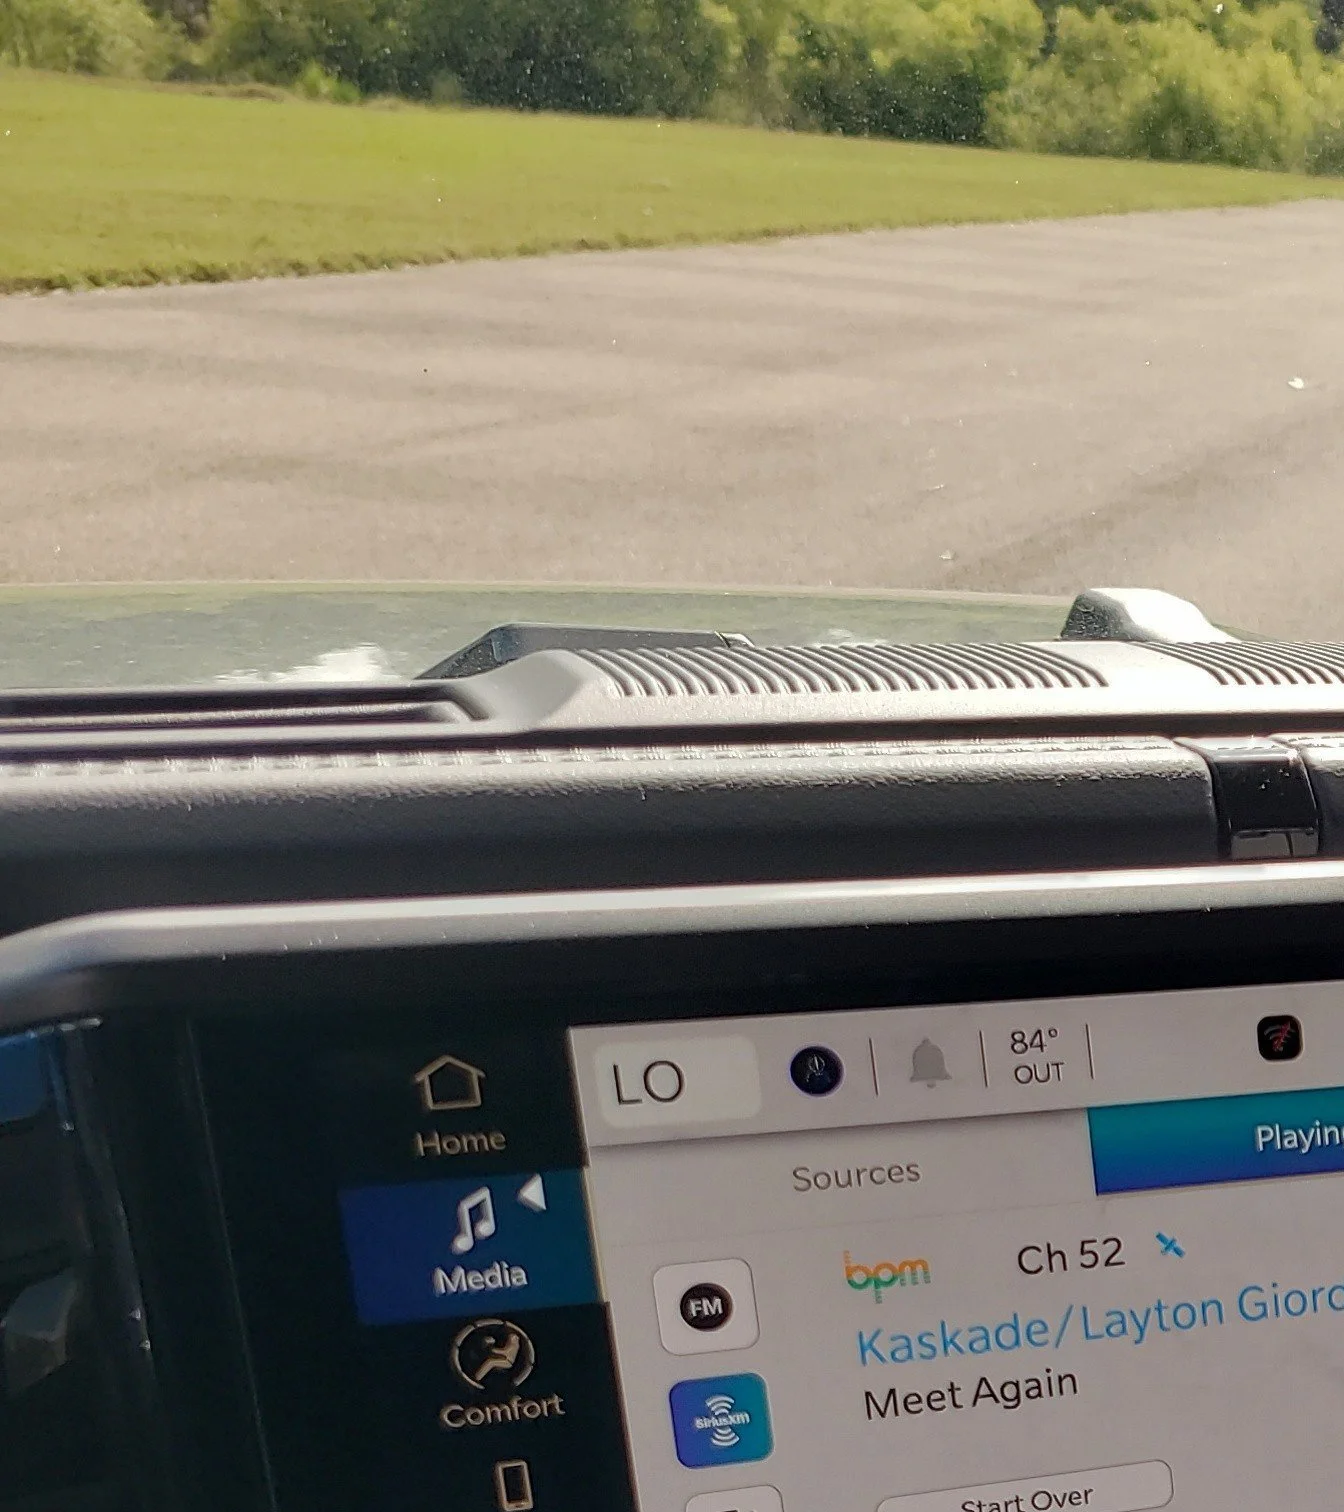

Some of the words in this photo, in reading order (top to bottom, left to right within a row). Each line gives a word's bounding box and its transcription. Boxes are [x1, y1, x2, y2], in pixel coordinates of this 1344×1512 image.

[613, 1059, 685, 1105] LO
[1014, 1061, 1066, 1086] OUT
[416, 1129, 506, 1158] Home
[792, 1158, 921, 1193] Sources
[1016, 1241, 1068, 1277] Ch
[1079, 1237, 1126, 1270] 52
[434, 1262, 528, 1295] Media
[843, 1250, 931, 1304] bpm
[689, 1296, 724, 1317] FM
[857, 1296, 1225, 1367] Kaskade/Layton
[440, 1392, 566, 1431] Comfort
[864, 1386, 962, 1421] Meet
[972, 1369, 1079, 1411] Again
